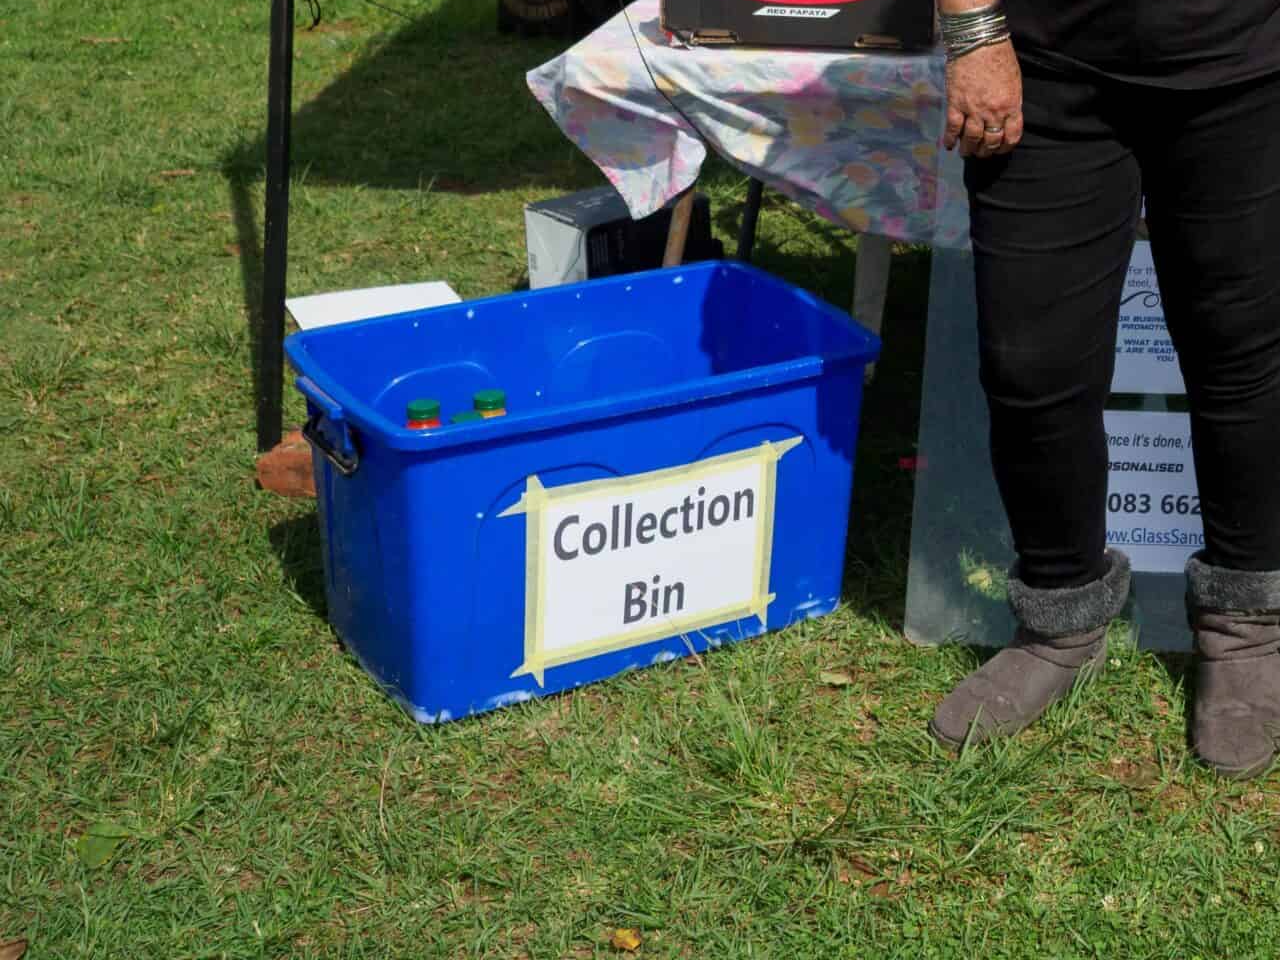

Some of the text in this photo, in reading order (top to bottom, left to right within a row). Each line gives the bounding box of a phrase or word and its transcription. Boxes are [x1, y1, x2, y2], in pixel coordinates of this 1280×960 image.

[789, 9, 827, 17] PAPAYA
[1132, 433, 1149, 447] it's
[1153, 434, 1184, 449] done,
[1108, 493, 1202, 515] 083 662
[553, 486, 754, 561] Collection
[623, 575, 685, 625] Bin
